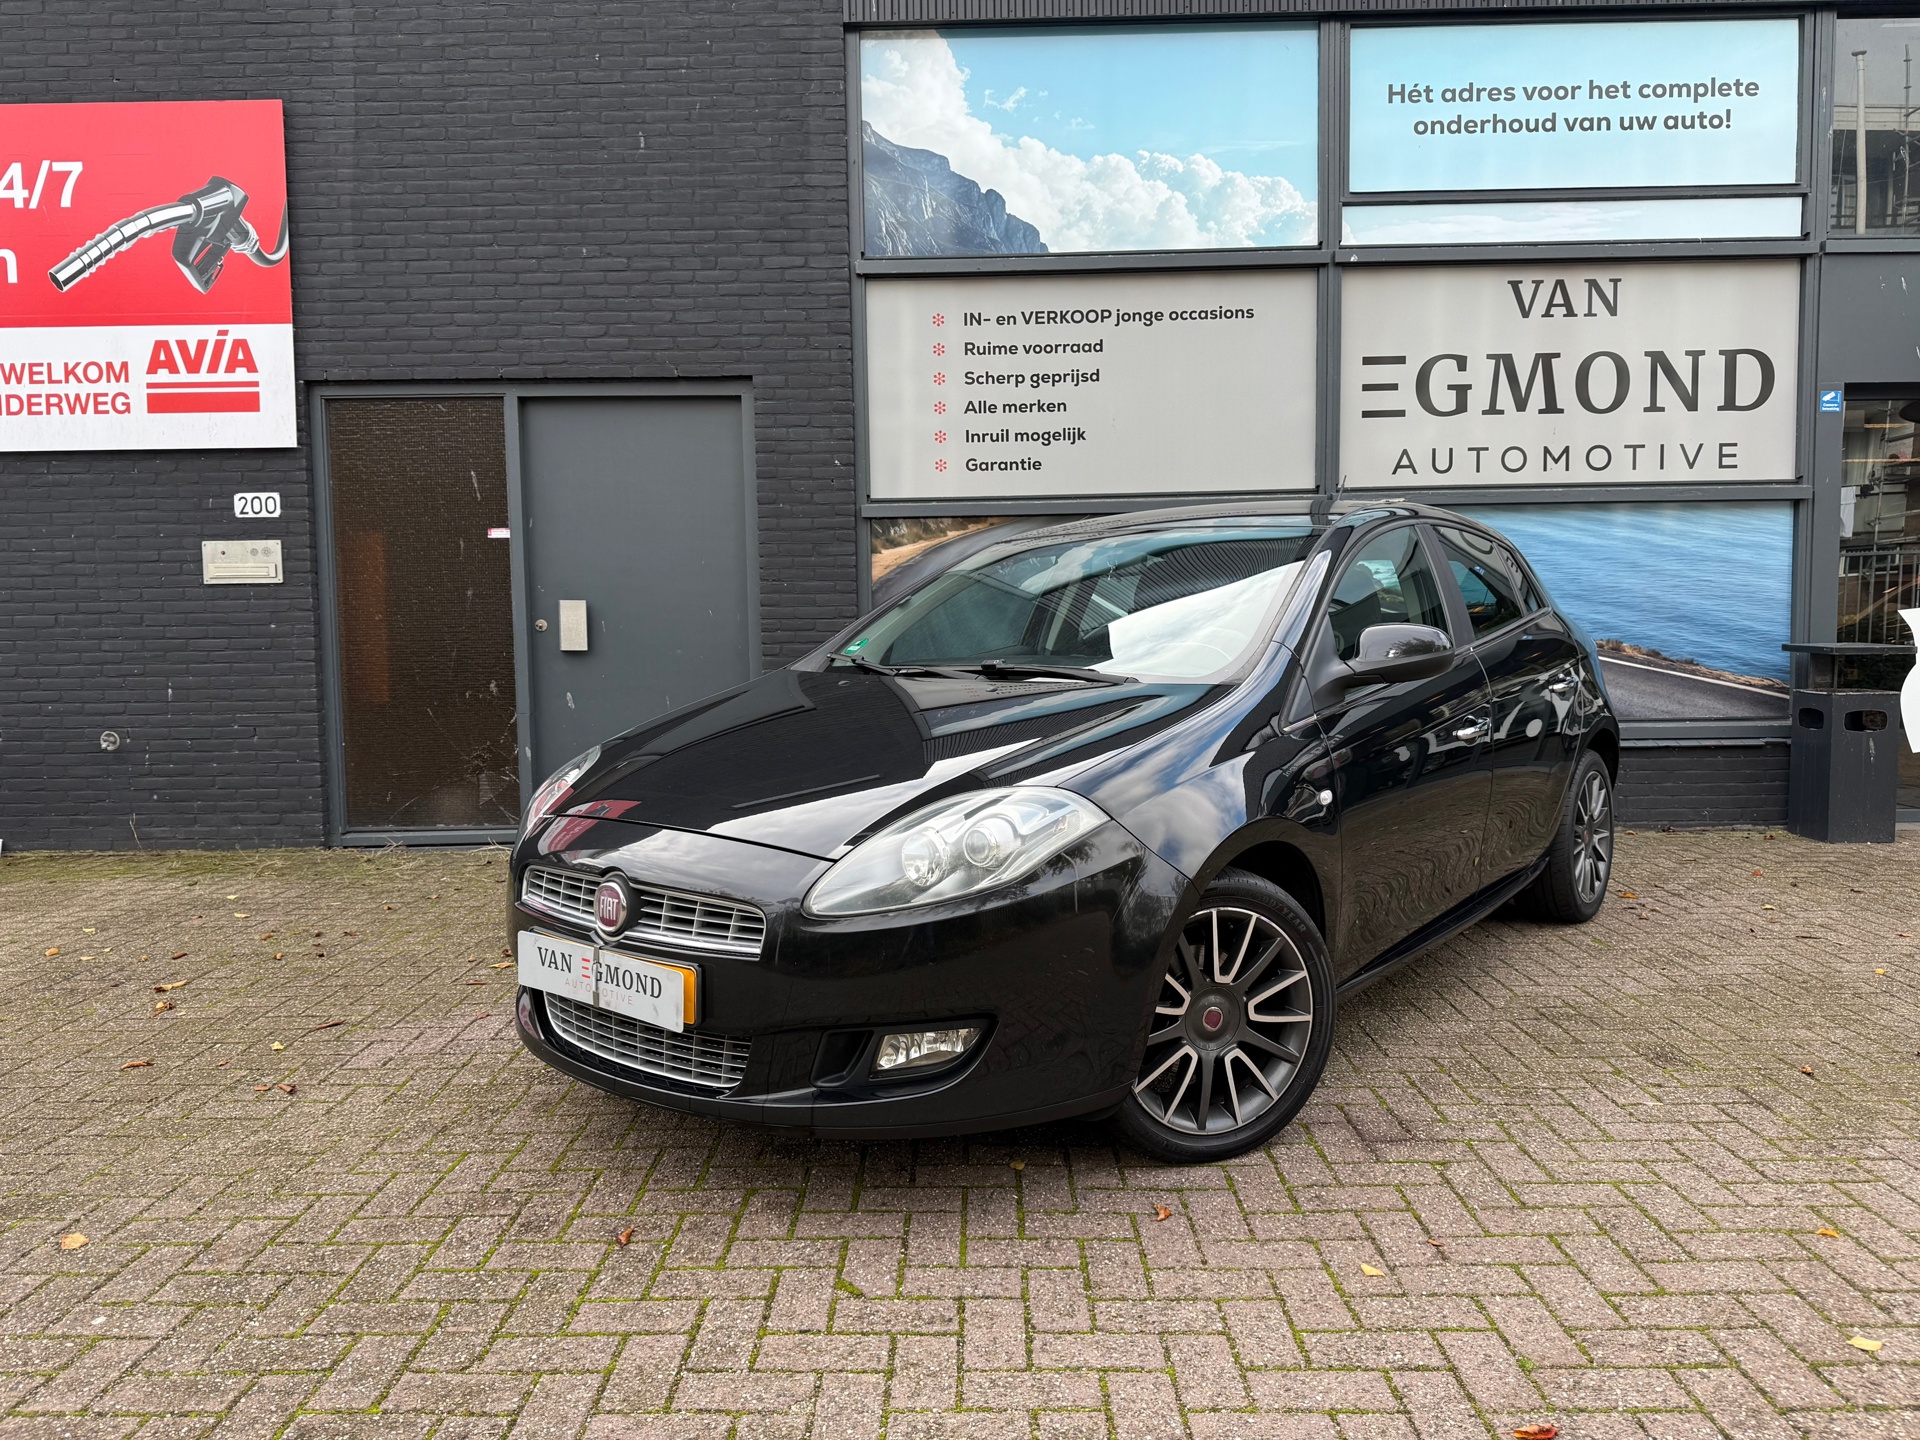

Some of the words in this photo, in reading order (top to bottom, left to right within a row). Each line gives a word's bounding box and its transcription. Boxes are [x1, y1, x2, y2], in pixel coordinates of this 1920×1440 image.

[1387, 81, 1434, 104] Hét
[1440, 81, 1516, 103] adres
[1522, 81, 1582, 101] voor
[1588, 79, 1632, 100] het
[1638, 76, 1760, 104] complete
[1413, 112, 1557, 136] onderhoud
[1563, 115, 1611, 132] van
[1619, 114, 1658, 131] uw
[1663, 108, 1731, 130] auto!
[1507, 277, 1622, 319] VAN
[963, 312, 991, 327] IN-
[995, 313, 1017, 326] en
[1021, 309, 1112, 326] VERKOOP
[1114, 308, 1164, 327] jonge
[1168, 305, 1255, 322] occasions
[964, 341, 1019, 357] Ruime
[1022, 339, 1104, 355] voorraad
[0, 360, 130, 385] WELKOM
[964, 370, 1026, 388] Scherp
[1029, 368, 1100, 389] geprijsd
[1361, 348, 1776, 418] EGMOND
[963, 400, 998, 415] Alle
[1002, 399, 1067, 414] merken
[965, 428, 1010, 443] Inruil
[1014, 427, 1087, 447] mogelijk
[965, 456, 1043, 472] Garantie
[1391, 442, 1738, 475] AUTOMOTIVE
[237, 495, 277, 515] 200
[599, 896, 619, 922] FIAT
[537, 946, 573, 974] VAN
[565, 978, 633, 1006] AUTOOTIVE
